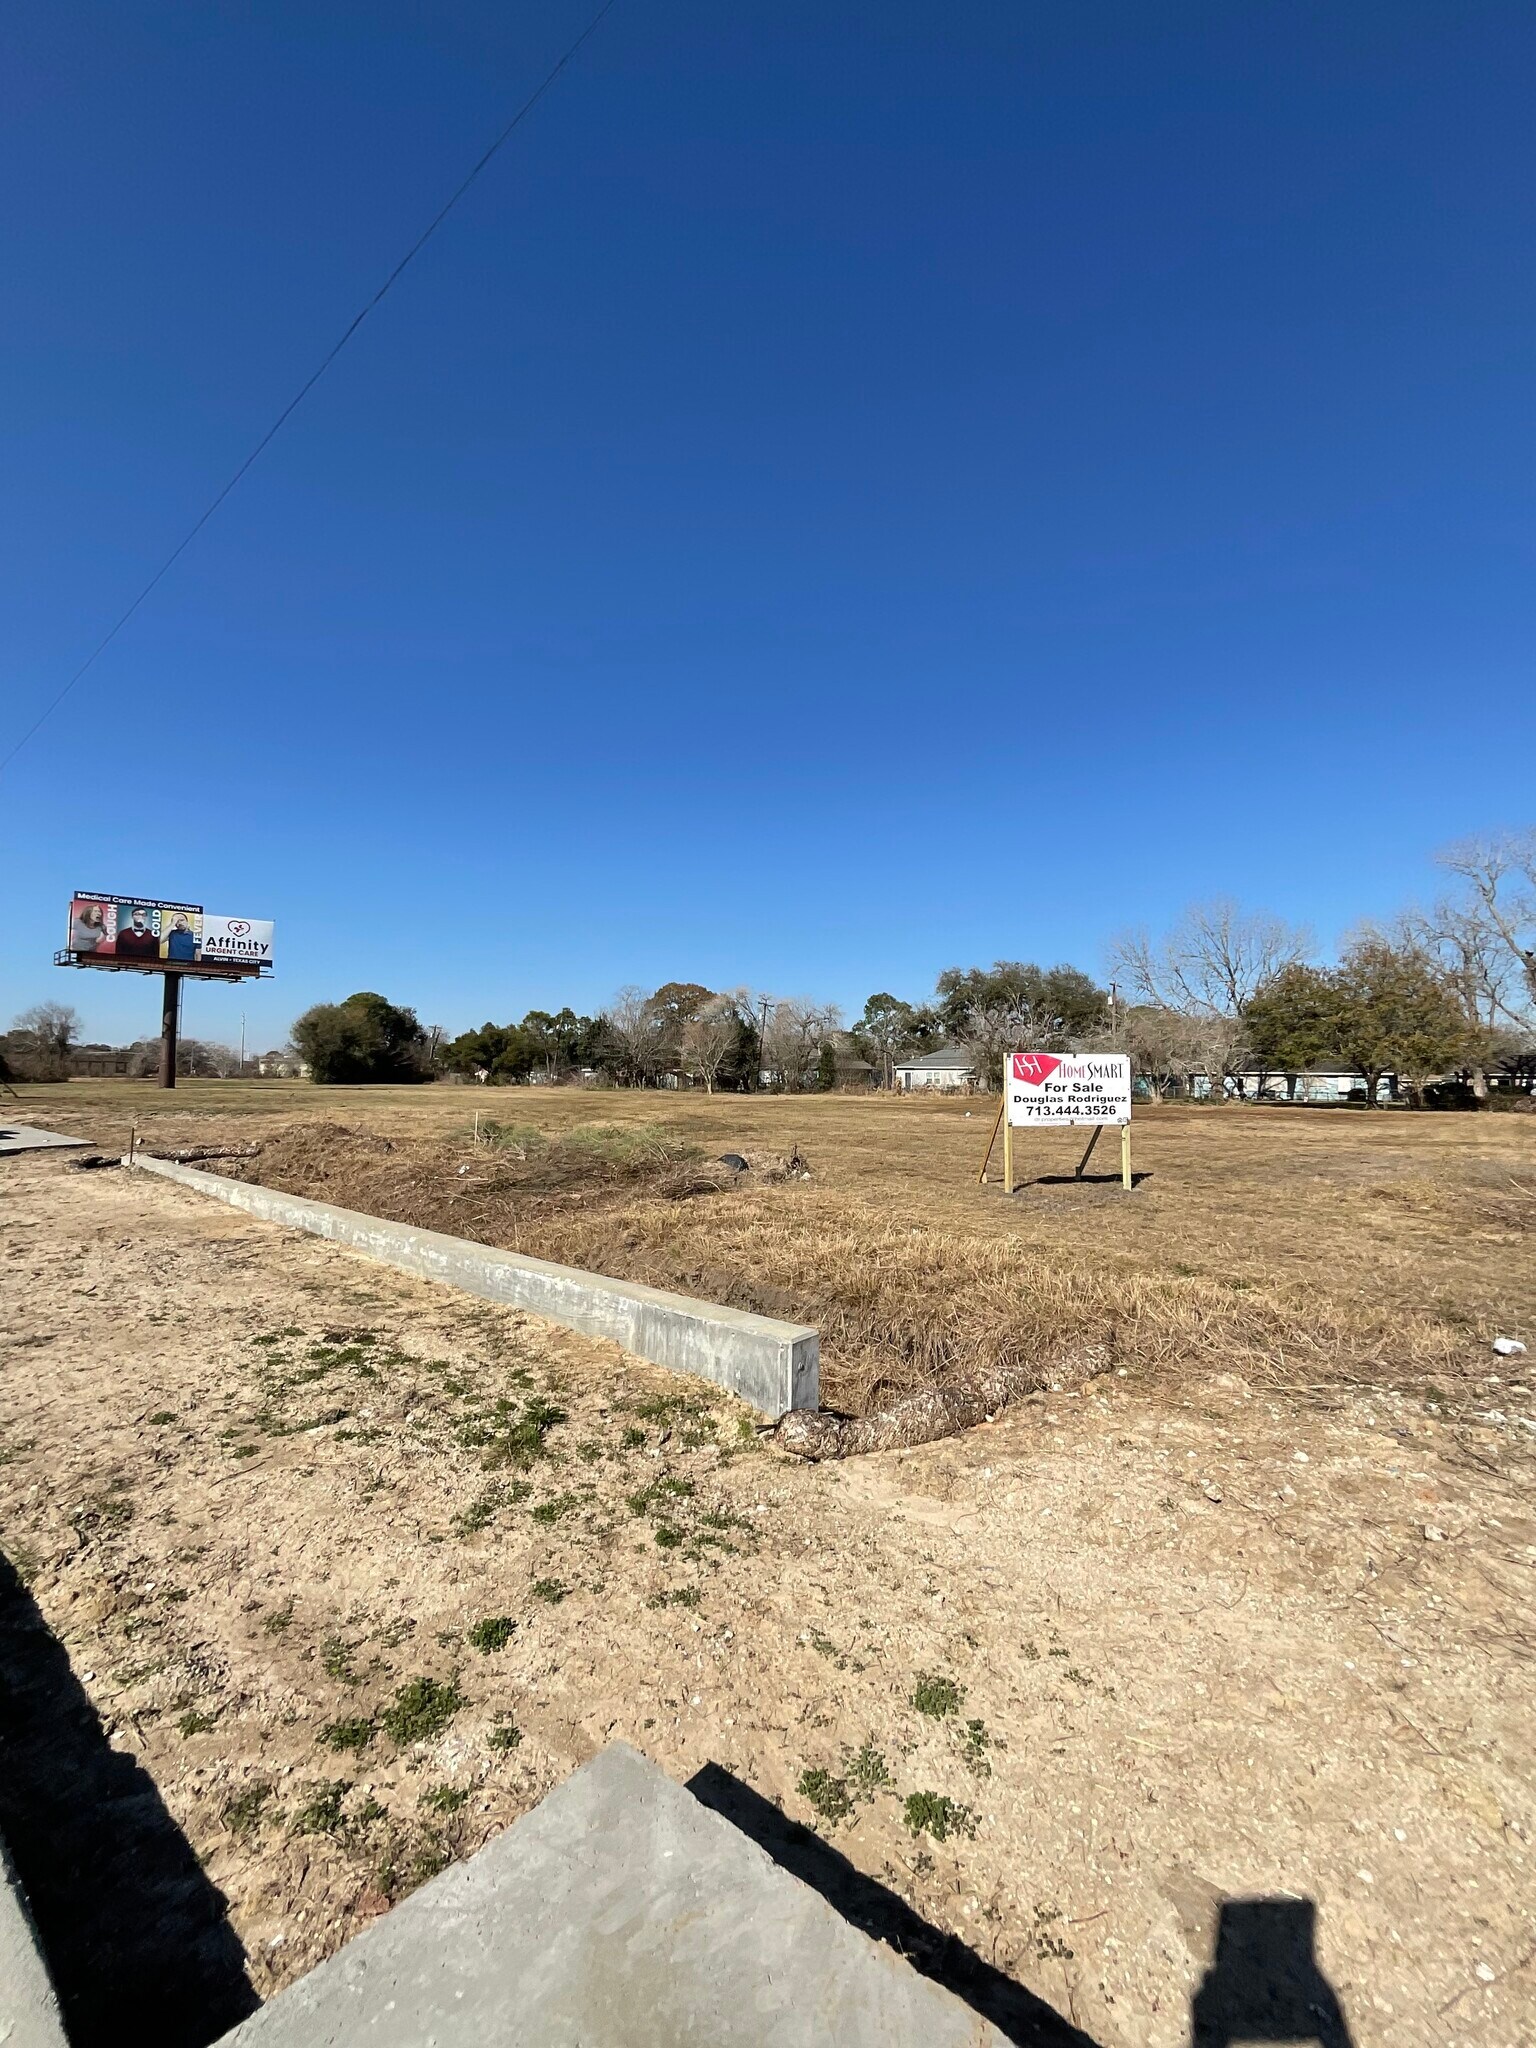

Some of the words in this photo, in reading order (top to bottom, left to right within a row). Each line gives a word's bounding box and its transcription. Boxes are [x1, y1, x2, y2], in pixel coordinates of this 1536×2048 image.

[77, 892, 111, 902] Medical
[112, 897, 132, 905] Care
[133, 899, 157, 908] Made
[157, 902, 200, 912] Convenient
[106, 904, 118, 943] COUGH
[151, 909, 161, 938] COLD
[193, 914, 203, 944] FEVER
[205, 947, 237, 955] URGENT
[238, 949, 259, 957] CARE
[206, 936, 269, 954] Affinity
[1044, 1082, 1068, 1093] For
[1072, 1082, 1104, 1093] Sale
[1013, 1095, 1064, 1104] Douglas
[1068, 1095, 1128, 1104] Rodriguez
[1026, 1105, 1117, 1116] 713.444.3526
